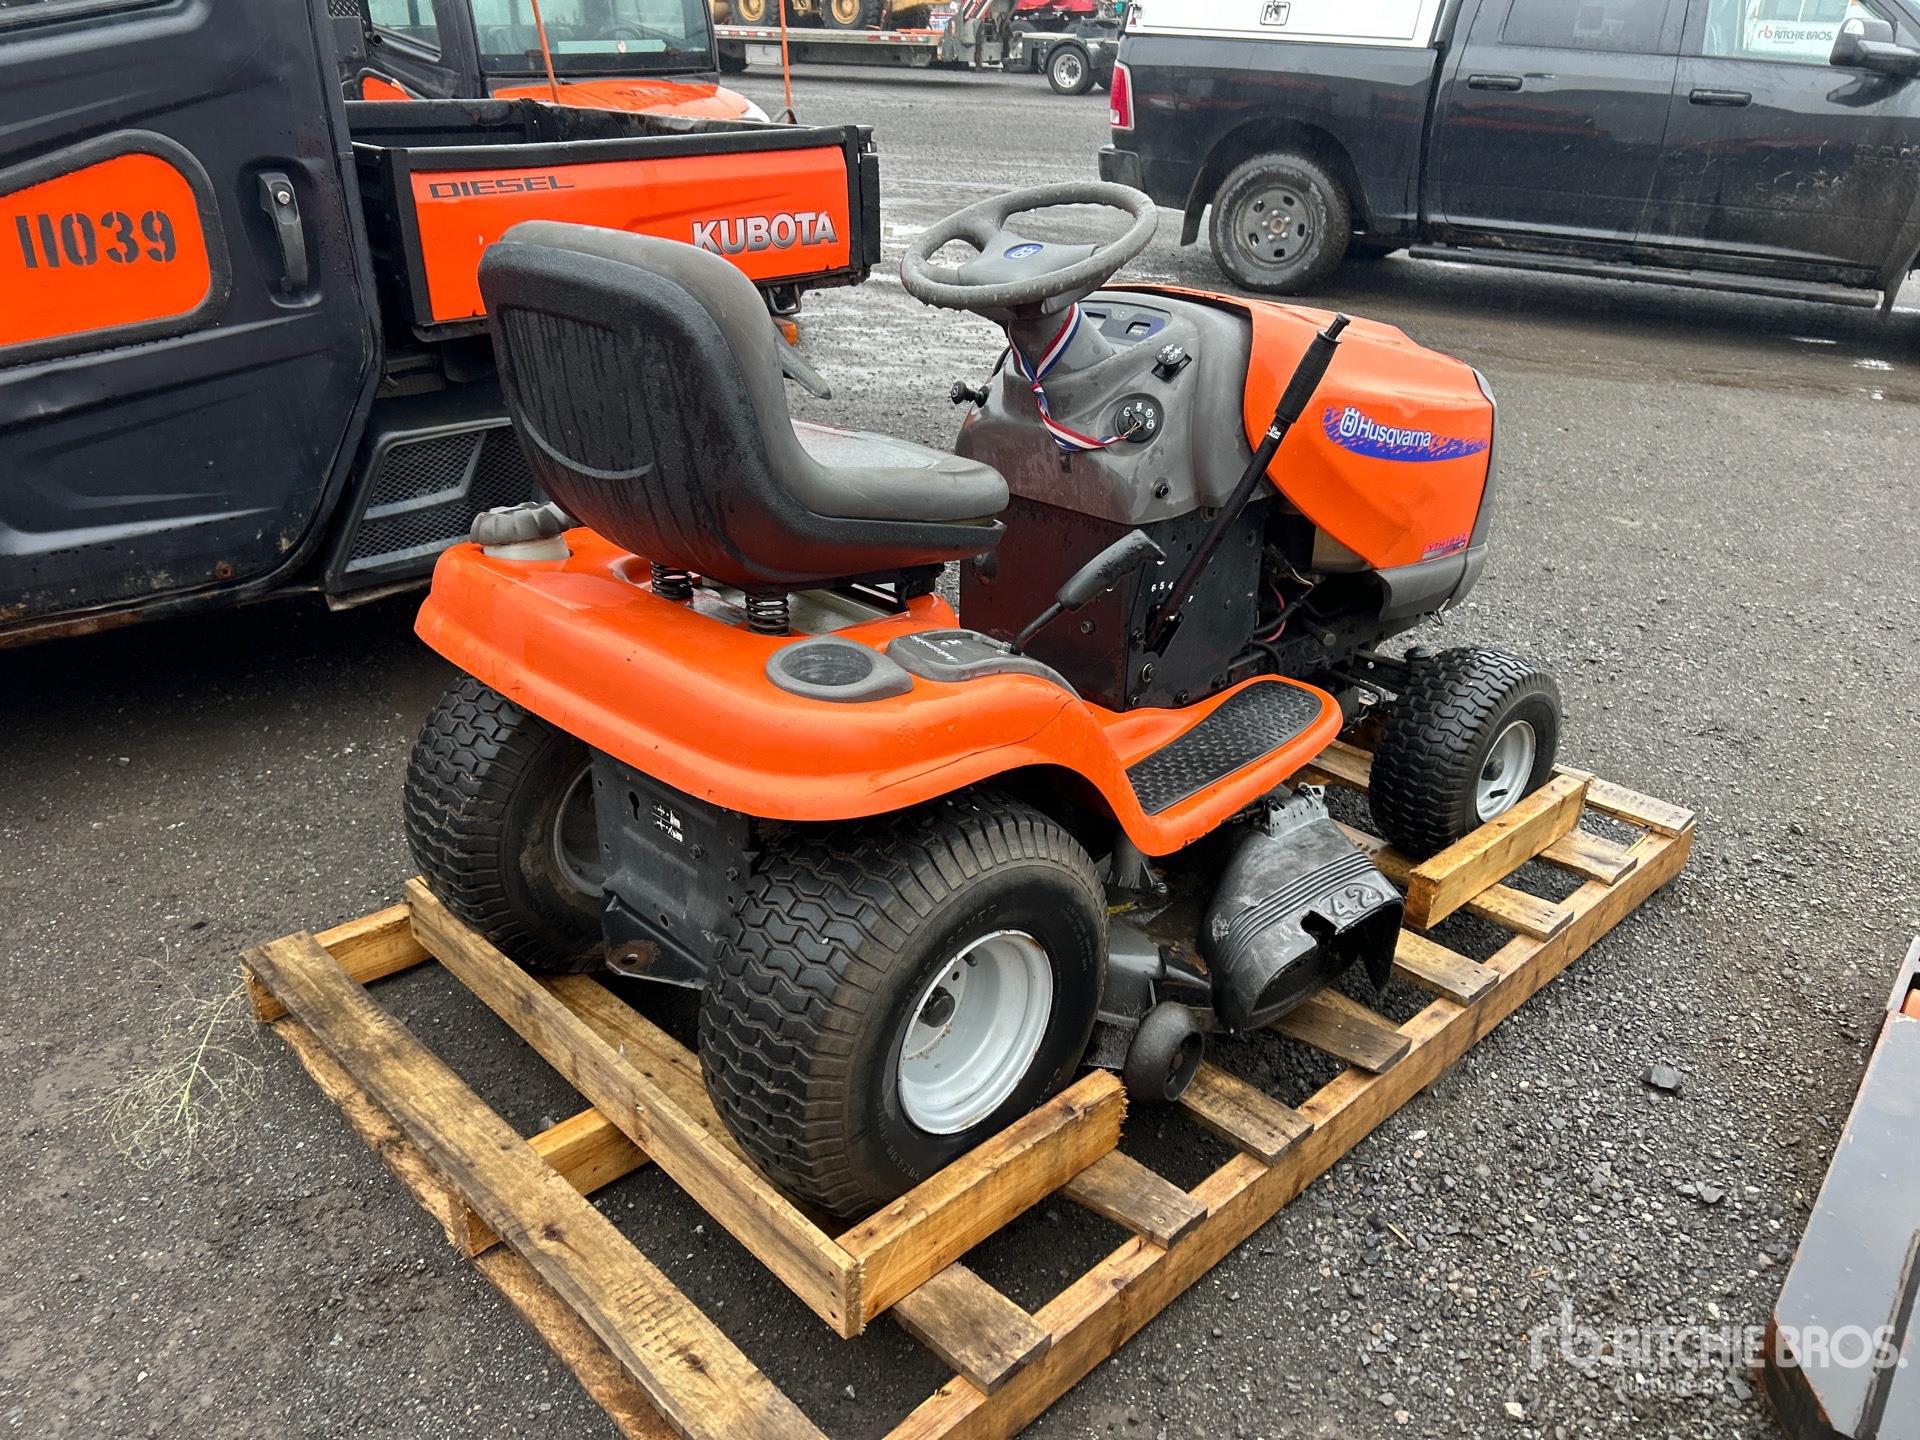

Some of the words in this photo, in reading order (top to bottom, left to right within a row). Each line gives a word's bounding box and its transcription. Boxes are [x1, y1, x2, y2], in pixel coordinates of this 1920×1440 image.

[1773, 30, 1805, 41] RITCHIE
[1806, 31, 1833, 41] BROS.
[429, 175, 575, 199] DIESEL
[15, 210, 177, 269] 11039
[692, 211, 839, 255] KUBOTA
[1357, 415, 1432, 448] Husqvarna
[1330, 885, 1379, 917] 42
